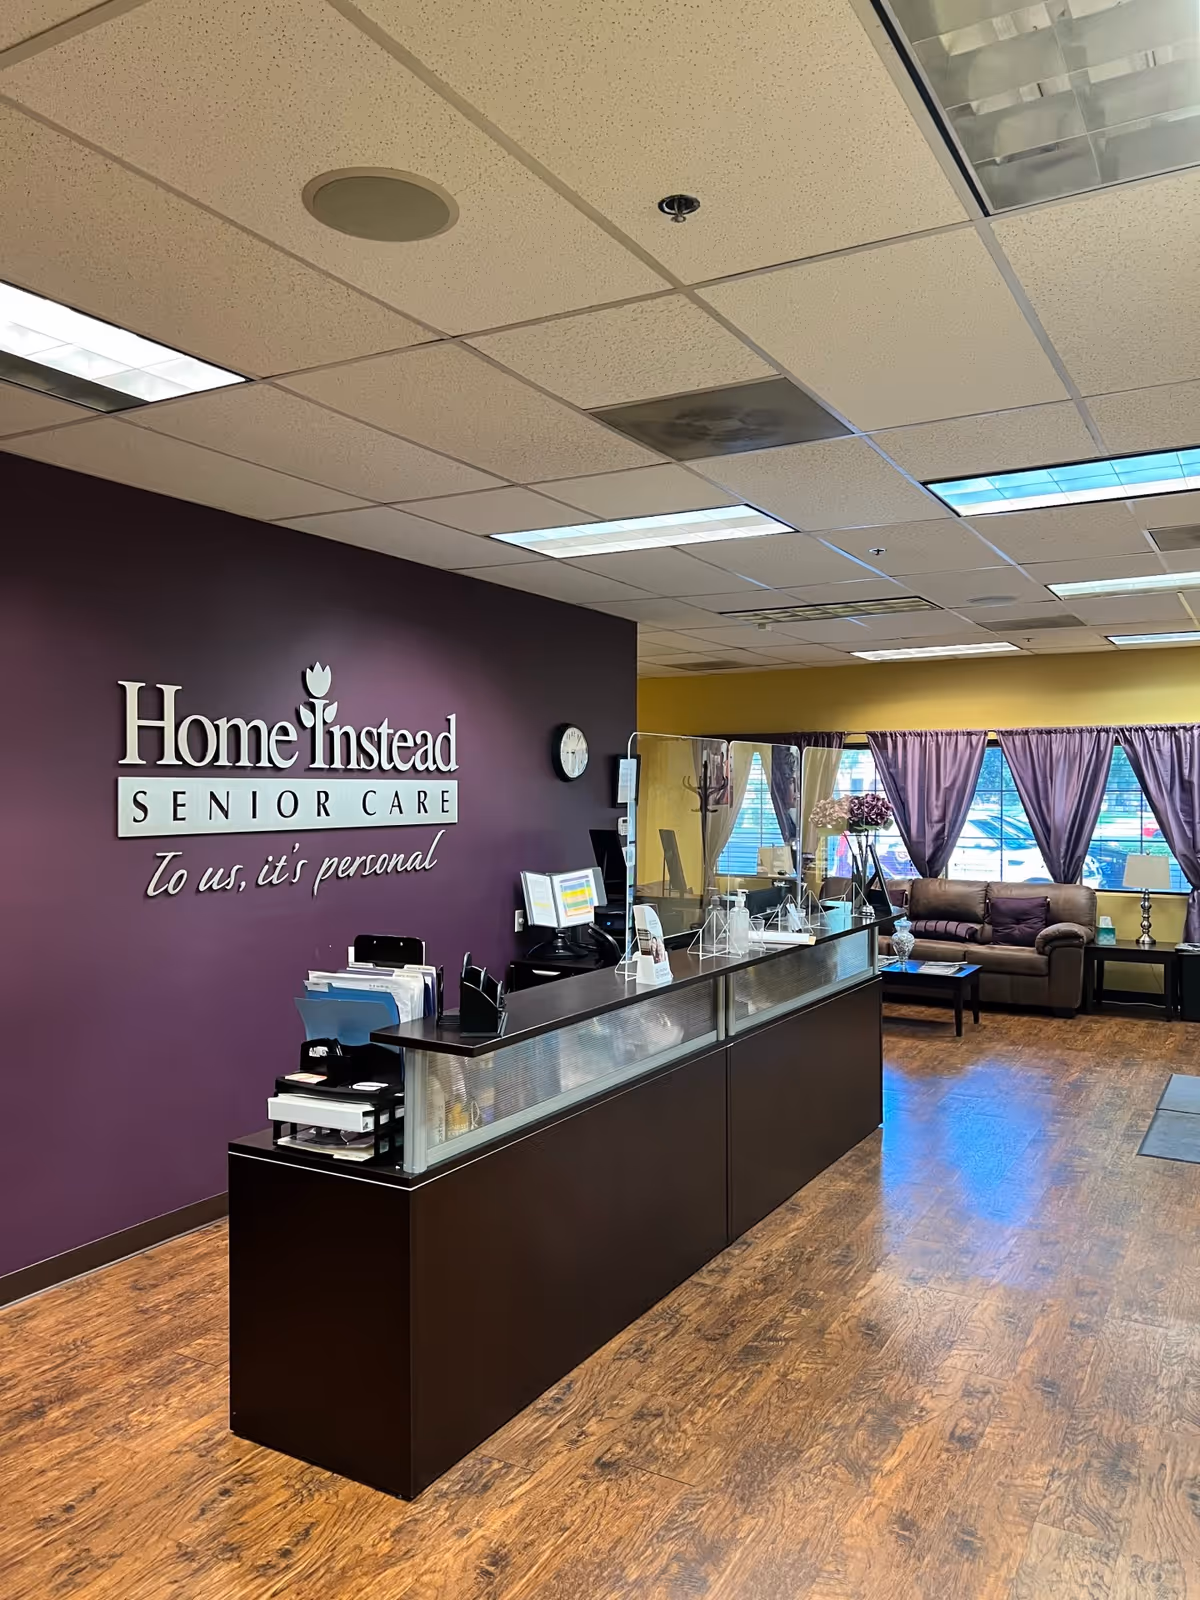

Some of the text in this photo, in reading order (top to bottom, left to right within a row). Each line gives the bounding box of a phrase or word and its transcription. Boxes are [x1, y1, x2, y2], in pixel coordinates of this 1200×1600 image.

[118, 680, 459, 772] Home Instead
[132, 789, 450, 823] SENIOR CARE
[147, 829, 446, 897] To us, it's personal
